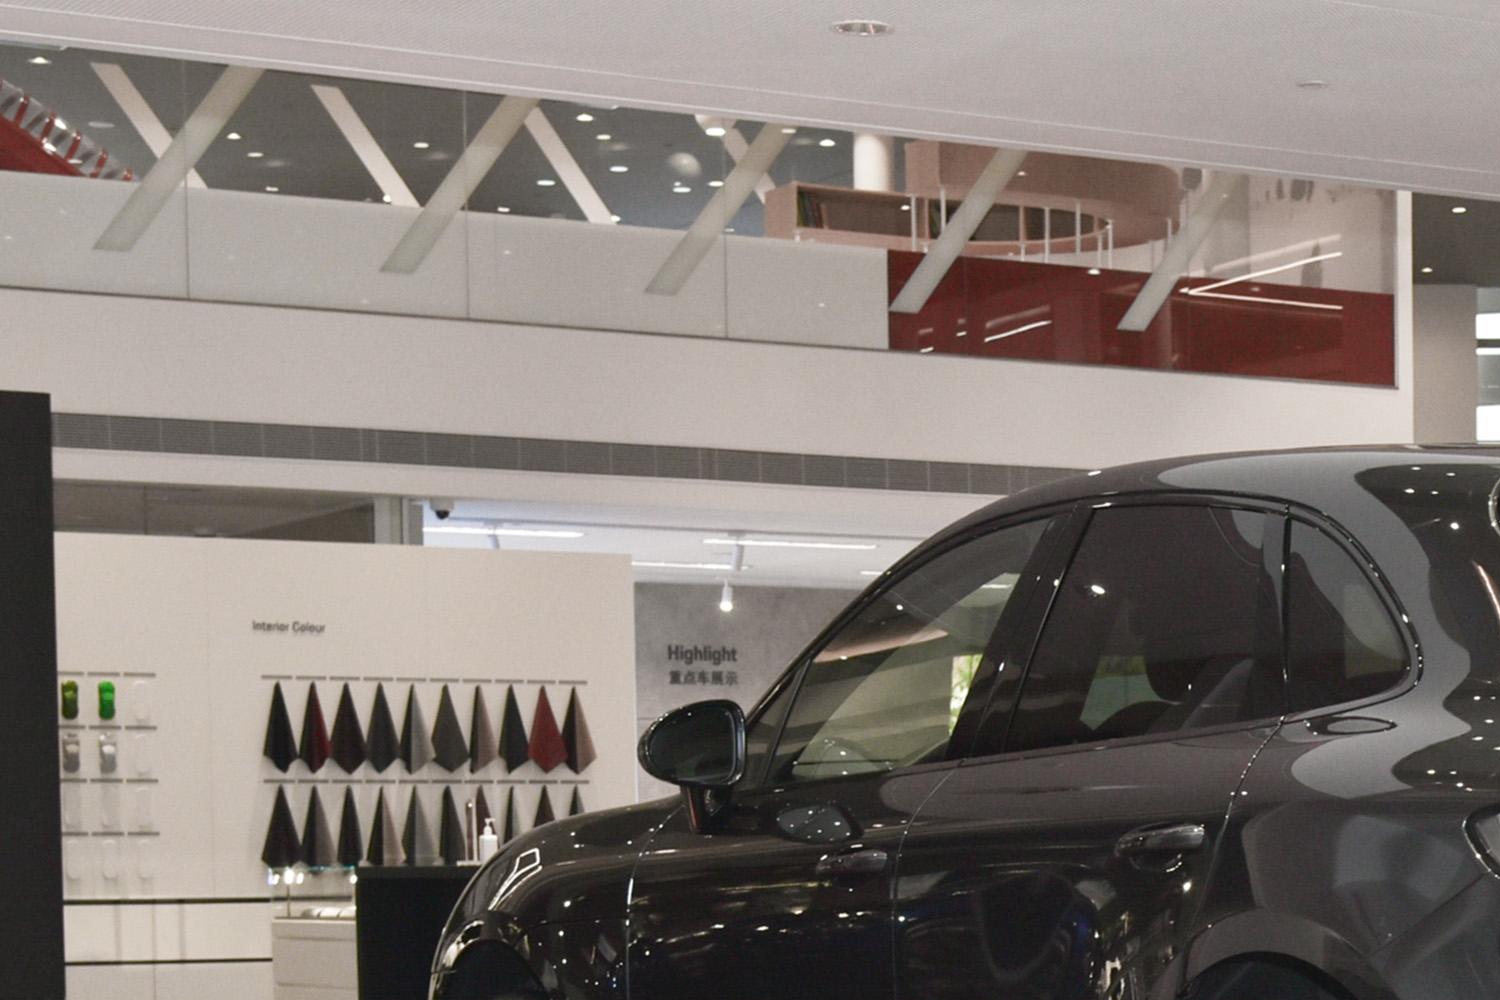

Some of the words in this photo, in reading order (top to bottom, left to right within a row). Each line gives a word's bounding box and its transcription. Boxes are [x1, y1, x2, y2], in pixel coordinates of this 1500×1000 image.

[252, 620, 289, 633] Interior
[292, 620, 326, 634] Colour
[667, 645, 738, 666] Highlight
[669, 670, 738, 687] 重点车展示
